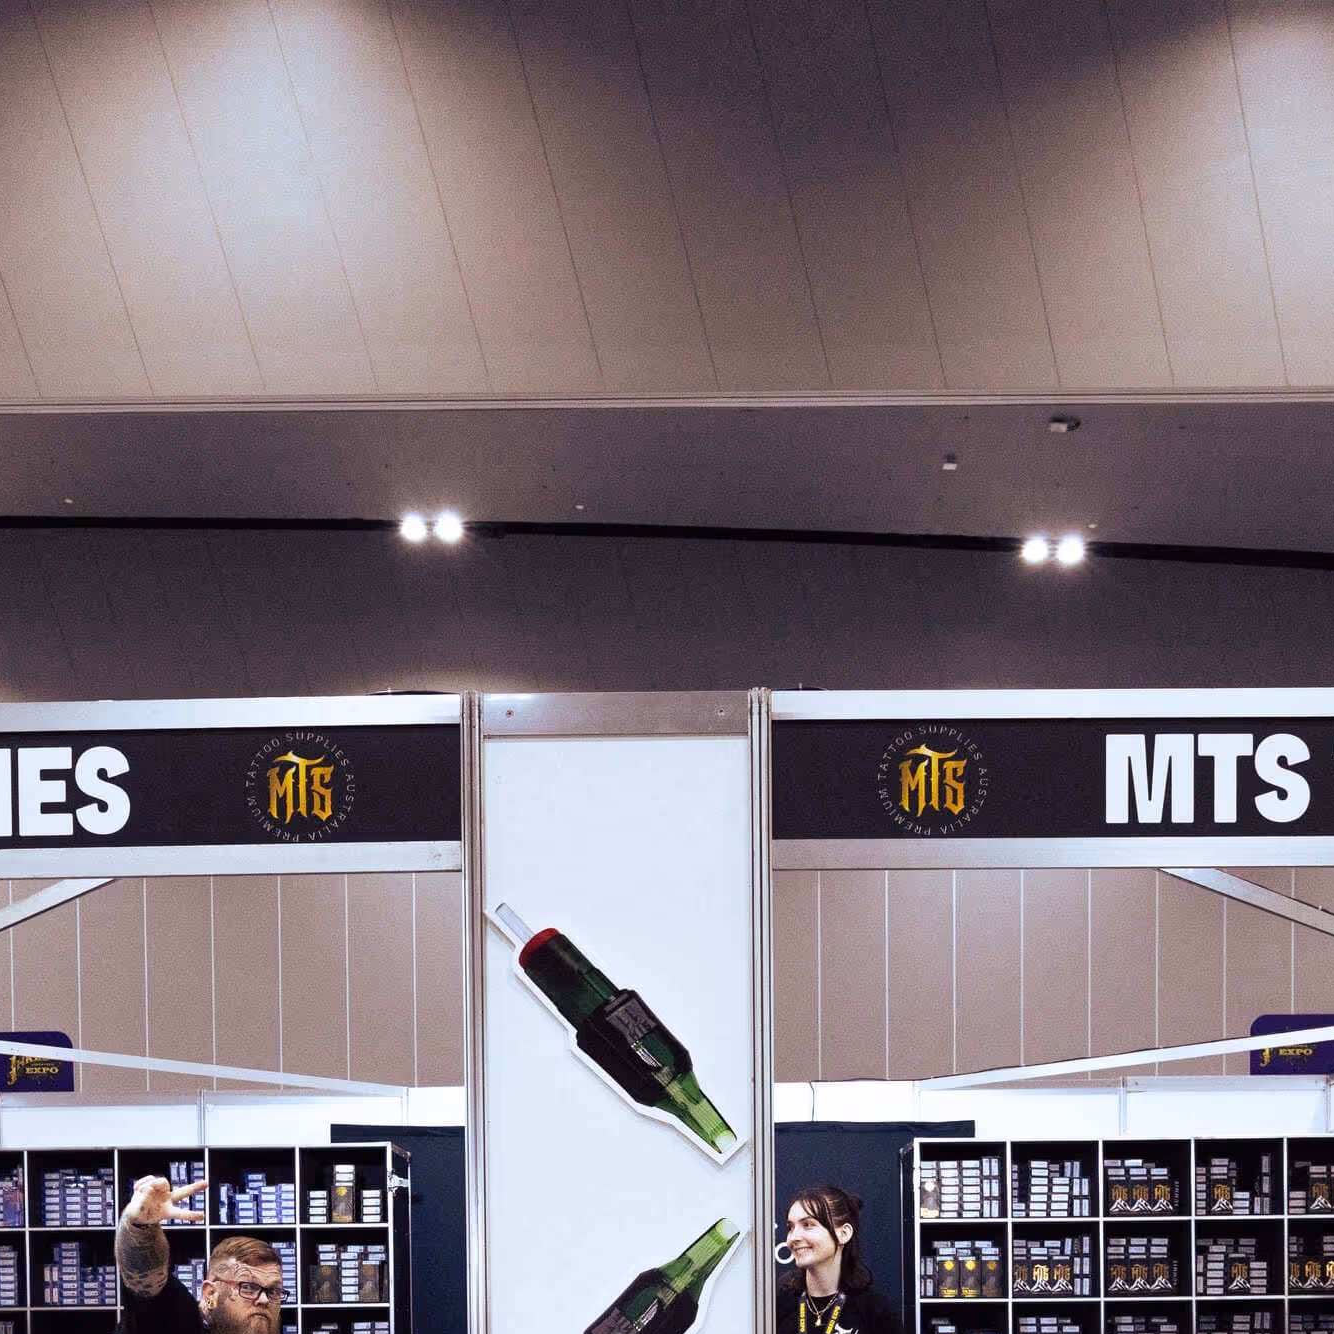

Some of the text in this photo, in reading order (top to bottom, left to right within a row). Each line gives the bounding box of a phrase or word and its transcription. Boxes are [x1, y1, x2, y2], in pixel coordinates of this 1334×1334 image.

[267, 750, 335, 824] MTS
[899, 743, 967, 817] MTS
[1106, 734, 1310, 823] MTS
[25, 1066, 59, 1074] EXPO
[1279, 1048, 1313, 1056] EXPO
